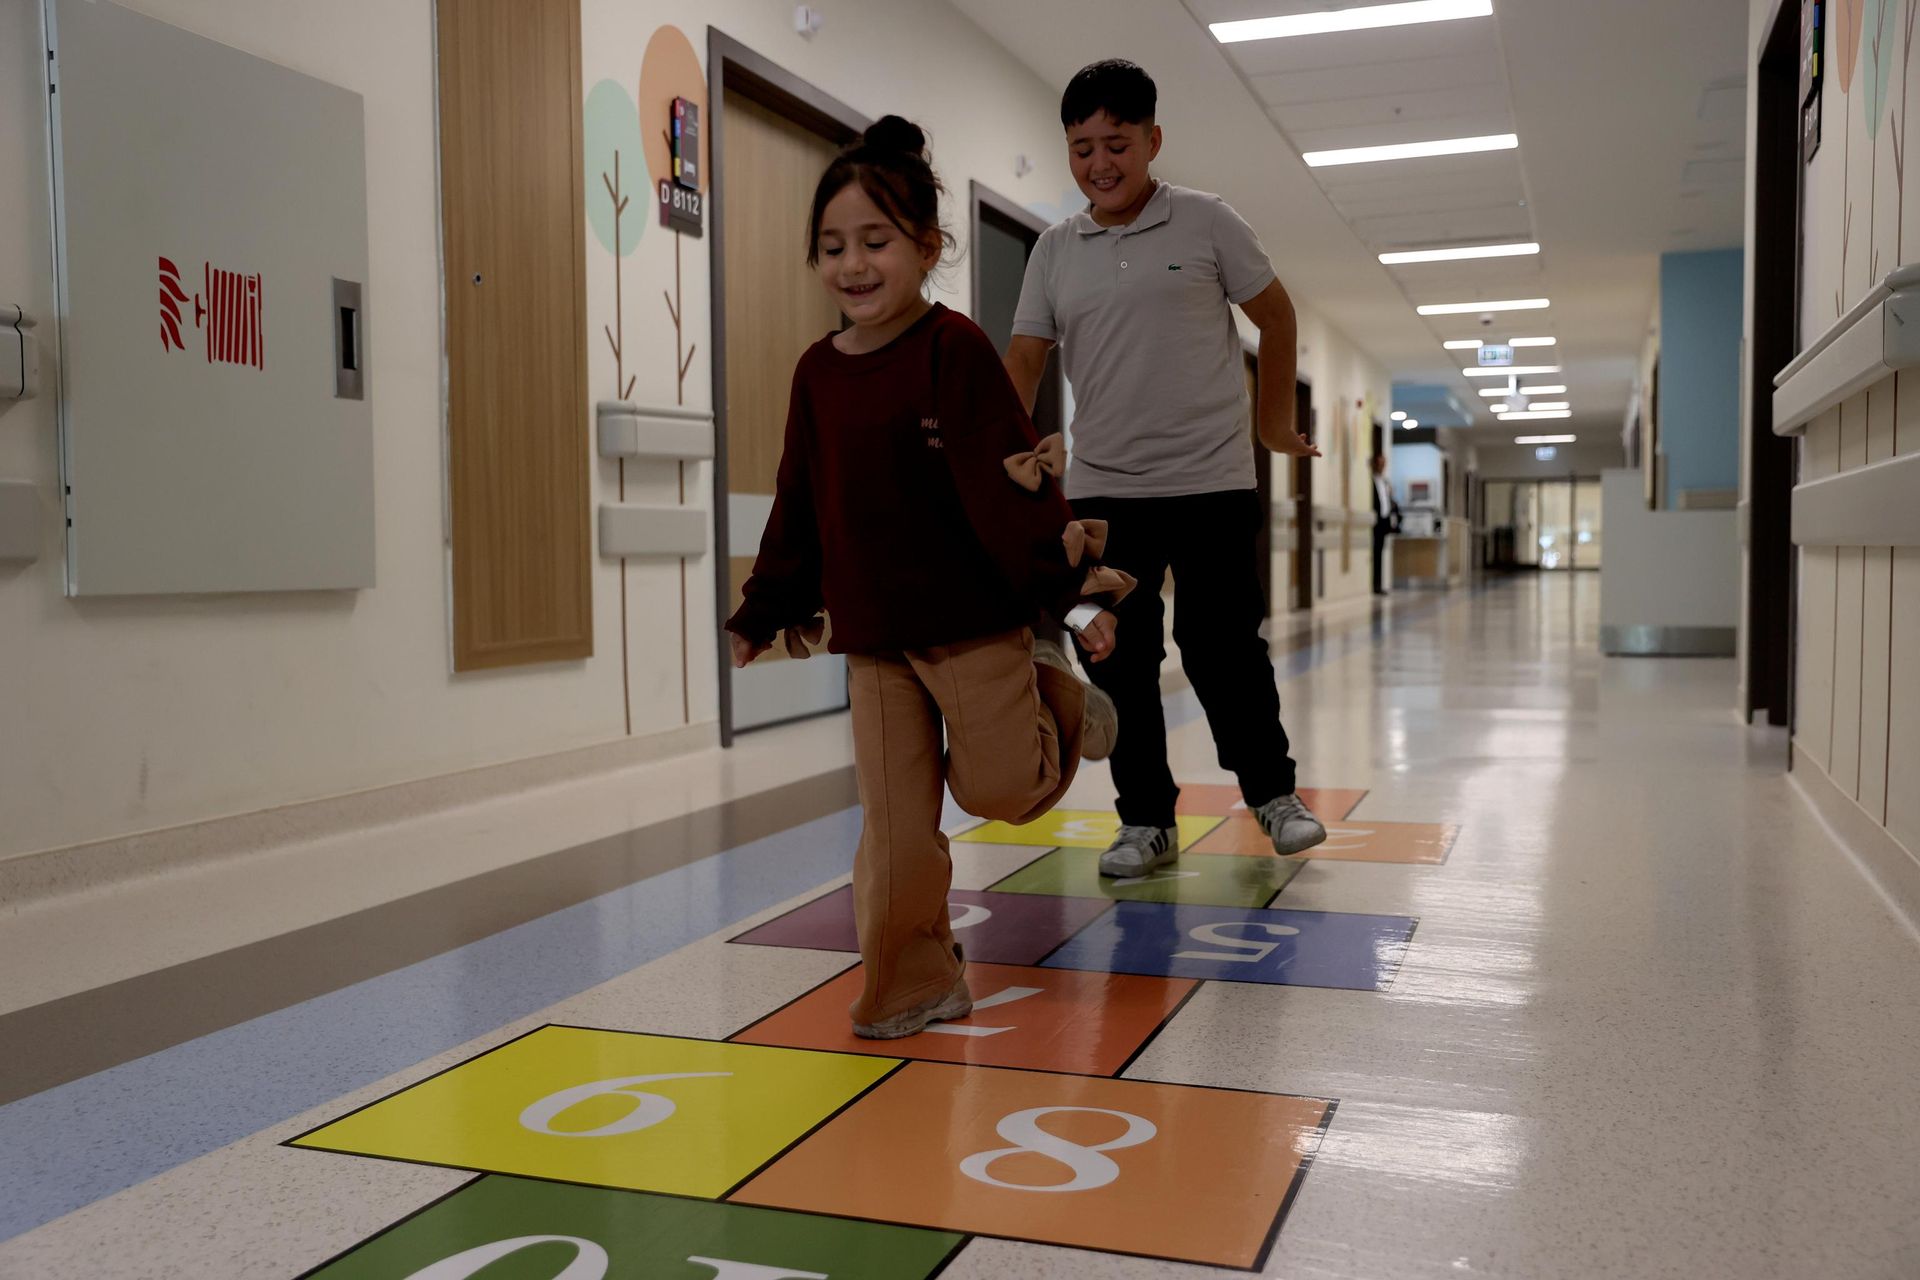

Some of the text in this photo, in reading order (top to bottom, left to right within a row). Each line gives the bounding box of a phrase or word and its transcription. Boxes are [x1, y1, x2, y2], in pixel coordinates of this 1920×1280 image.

[661, 183, 699, 215] D 8112
[1168, 922, 1300, 962] 5
[959, 1105, 1157, 1191] 8
